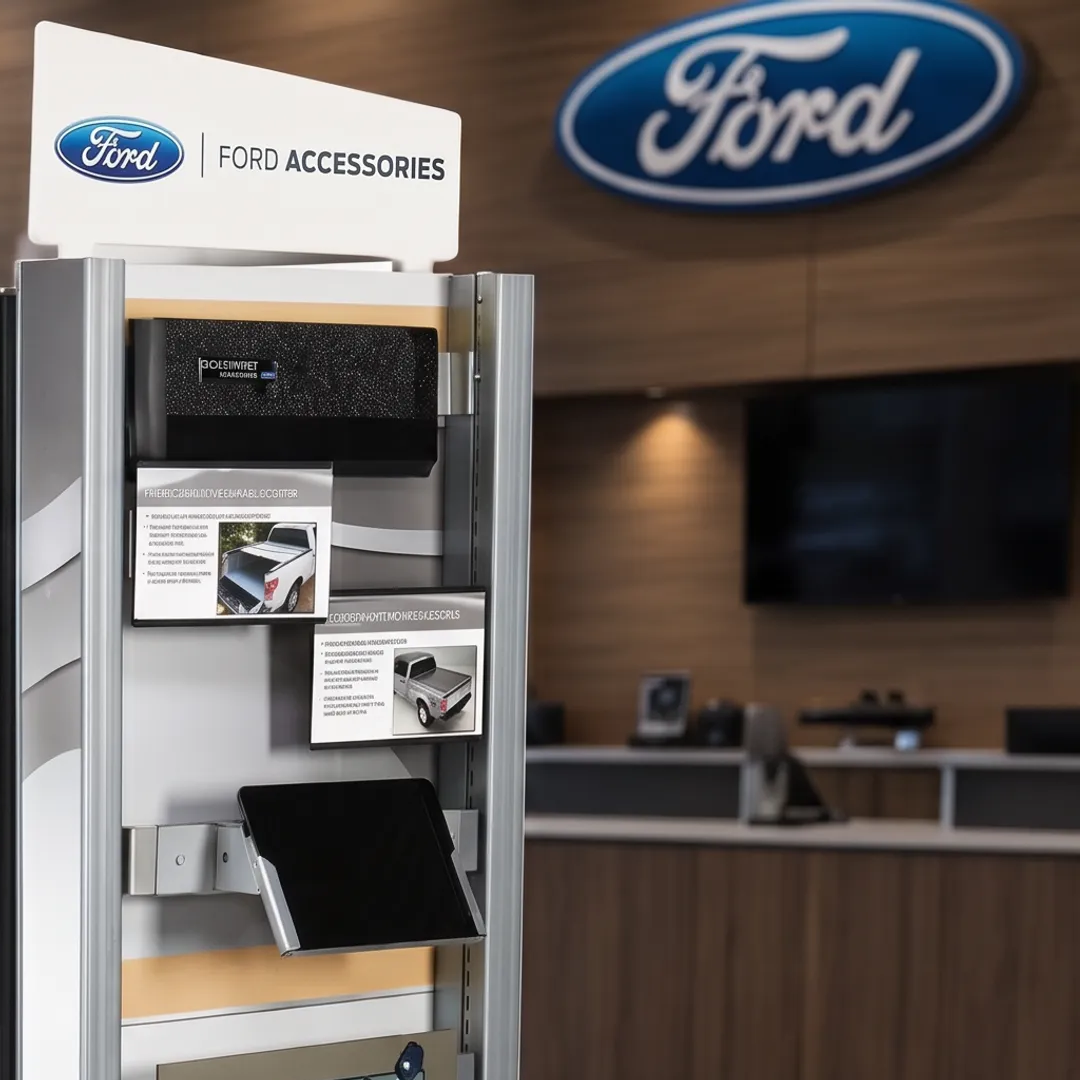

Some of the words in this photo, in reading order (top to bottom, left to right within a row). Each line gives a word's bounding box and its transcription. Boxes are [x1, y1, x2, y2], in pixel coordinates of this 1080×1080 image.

[637, 27, 921, 178] Ford
[81, 126, 161, 171] Ford
[219, 145, 279, 171] FORD
[285, 149, 446, 181] ACCESSORIES
